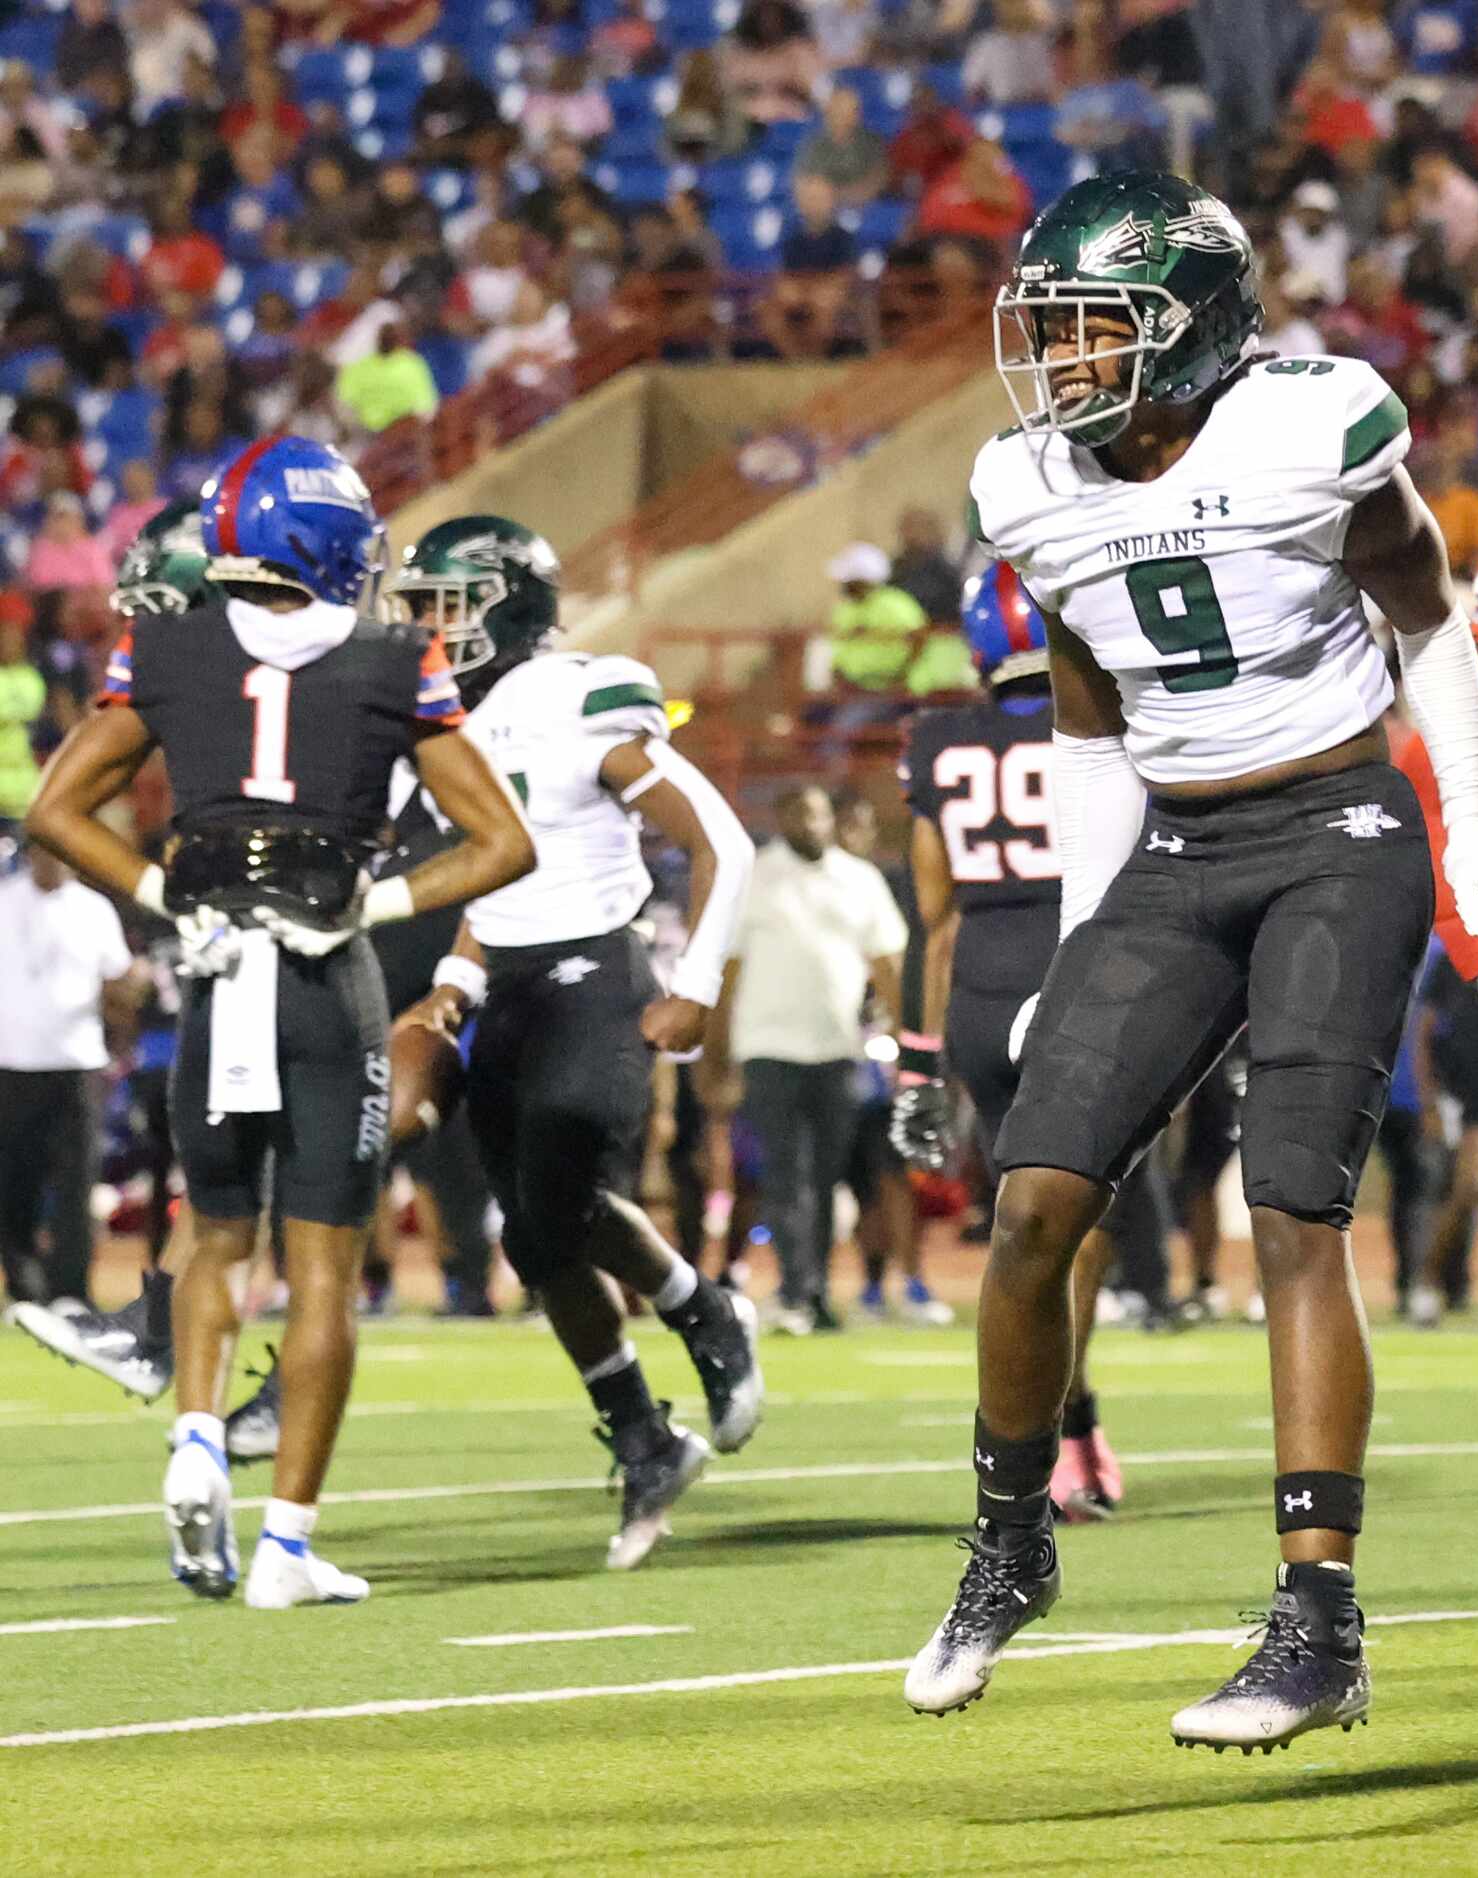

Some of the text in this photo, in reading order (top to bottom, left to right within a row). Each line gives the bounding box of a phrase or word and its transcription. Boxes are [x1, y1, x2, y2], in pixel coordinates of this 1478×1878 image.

[1104, 529, 1206, 562] INDIANS
[1125, 555, 1239, 693] 9
[240, 663, 296, 804] 1
[933, 741, 1062, 881] 29
